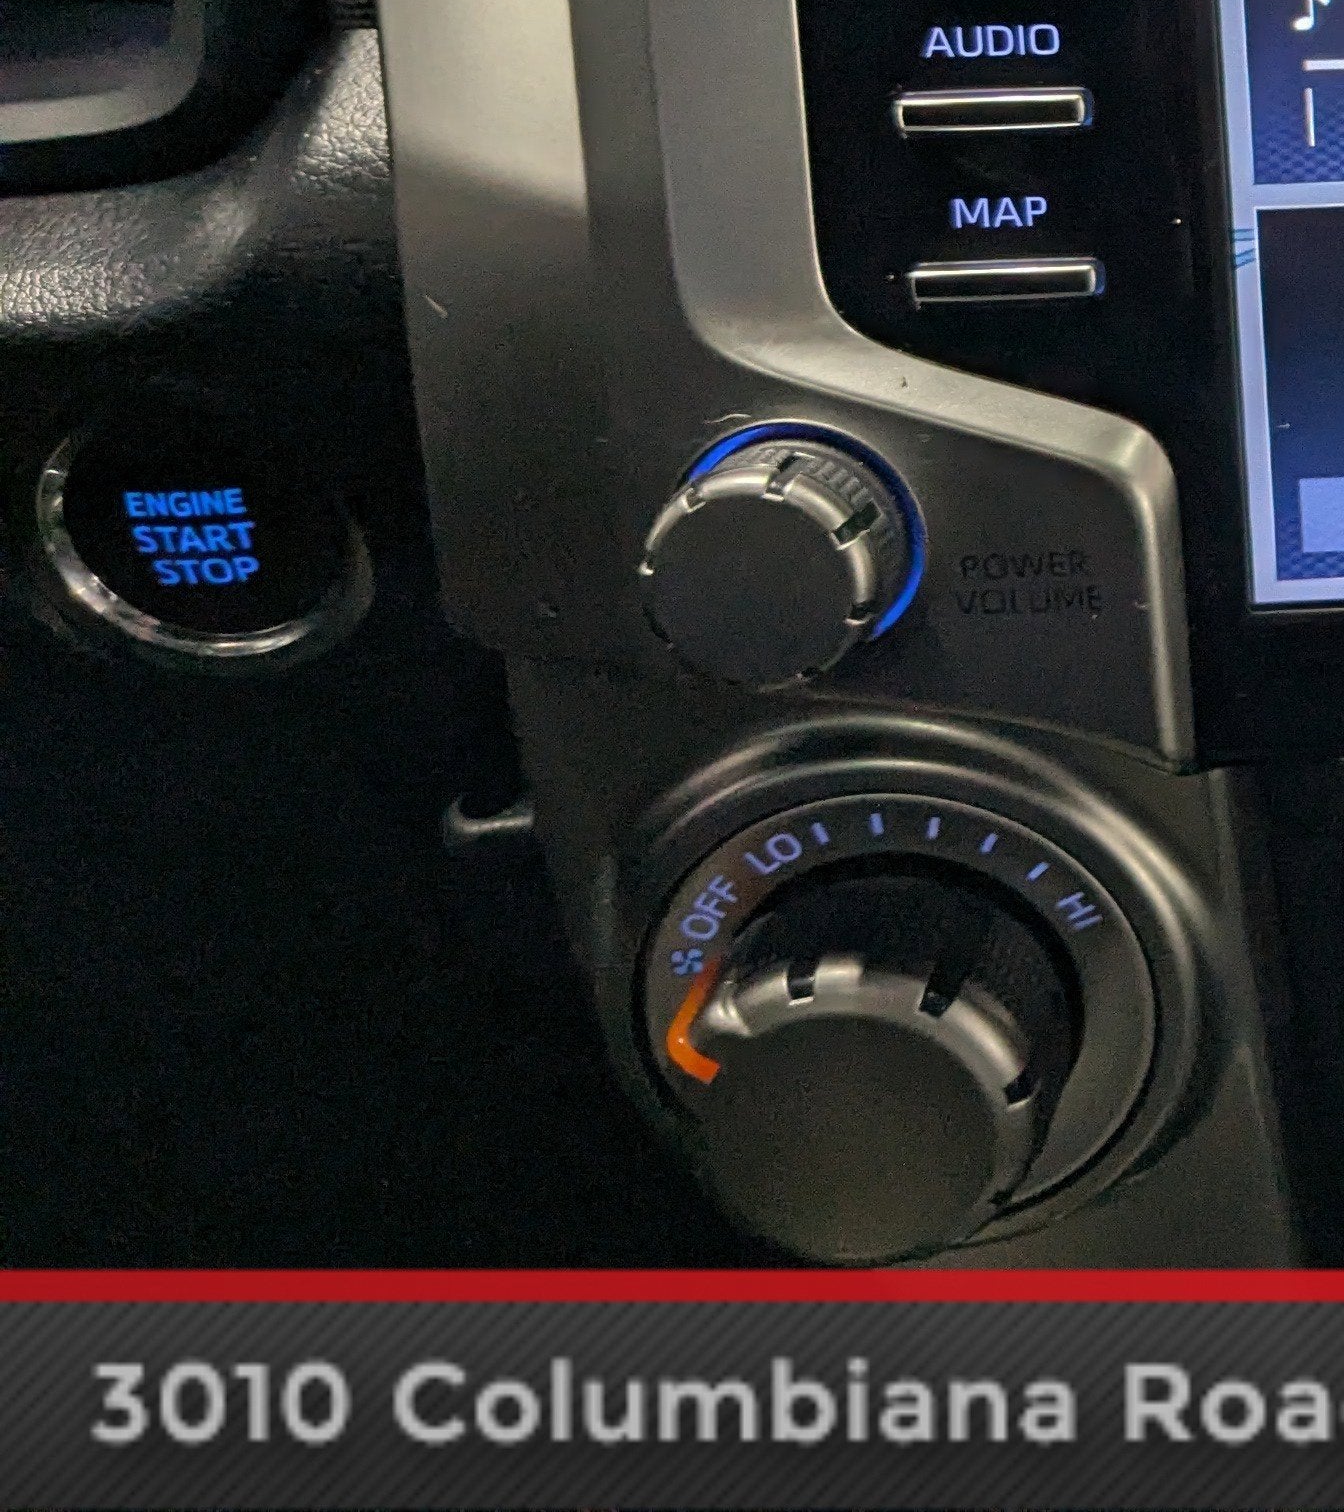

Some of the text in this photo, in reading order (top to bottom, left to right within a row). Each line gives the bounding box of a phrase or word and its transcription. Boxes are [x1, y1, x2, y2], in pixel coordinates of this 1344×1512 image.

[922, 23, 1060, 59] AUDIO
[949, 195, 1048, 228] MAP
[122, 487, 247, 519] ENGINE
[131, 521, 256, 555] START
[153, 555, 260, 586] STOP
[959, 550, 1091, 580] POWER
[952, 584, 1103, 615] VOLUME
[745, 832, 803, 878] LO
[680, 874, 740, 943] OFF
[1057, 890, 1105, 932] HI
